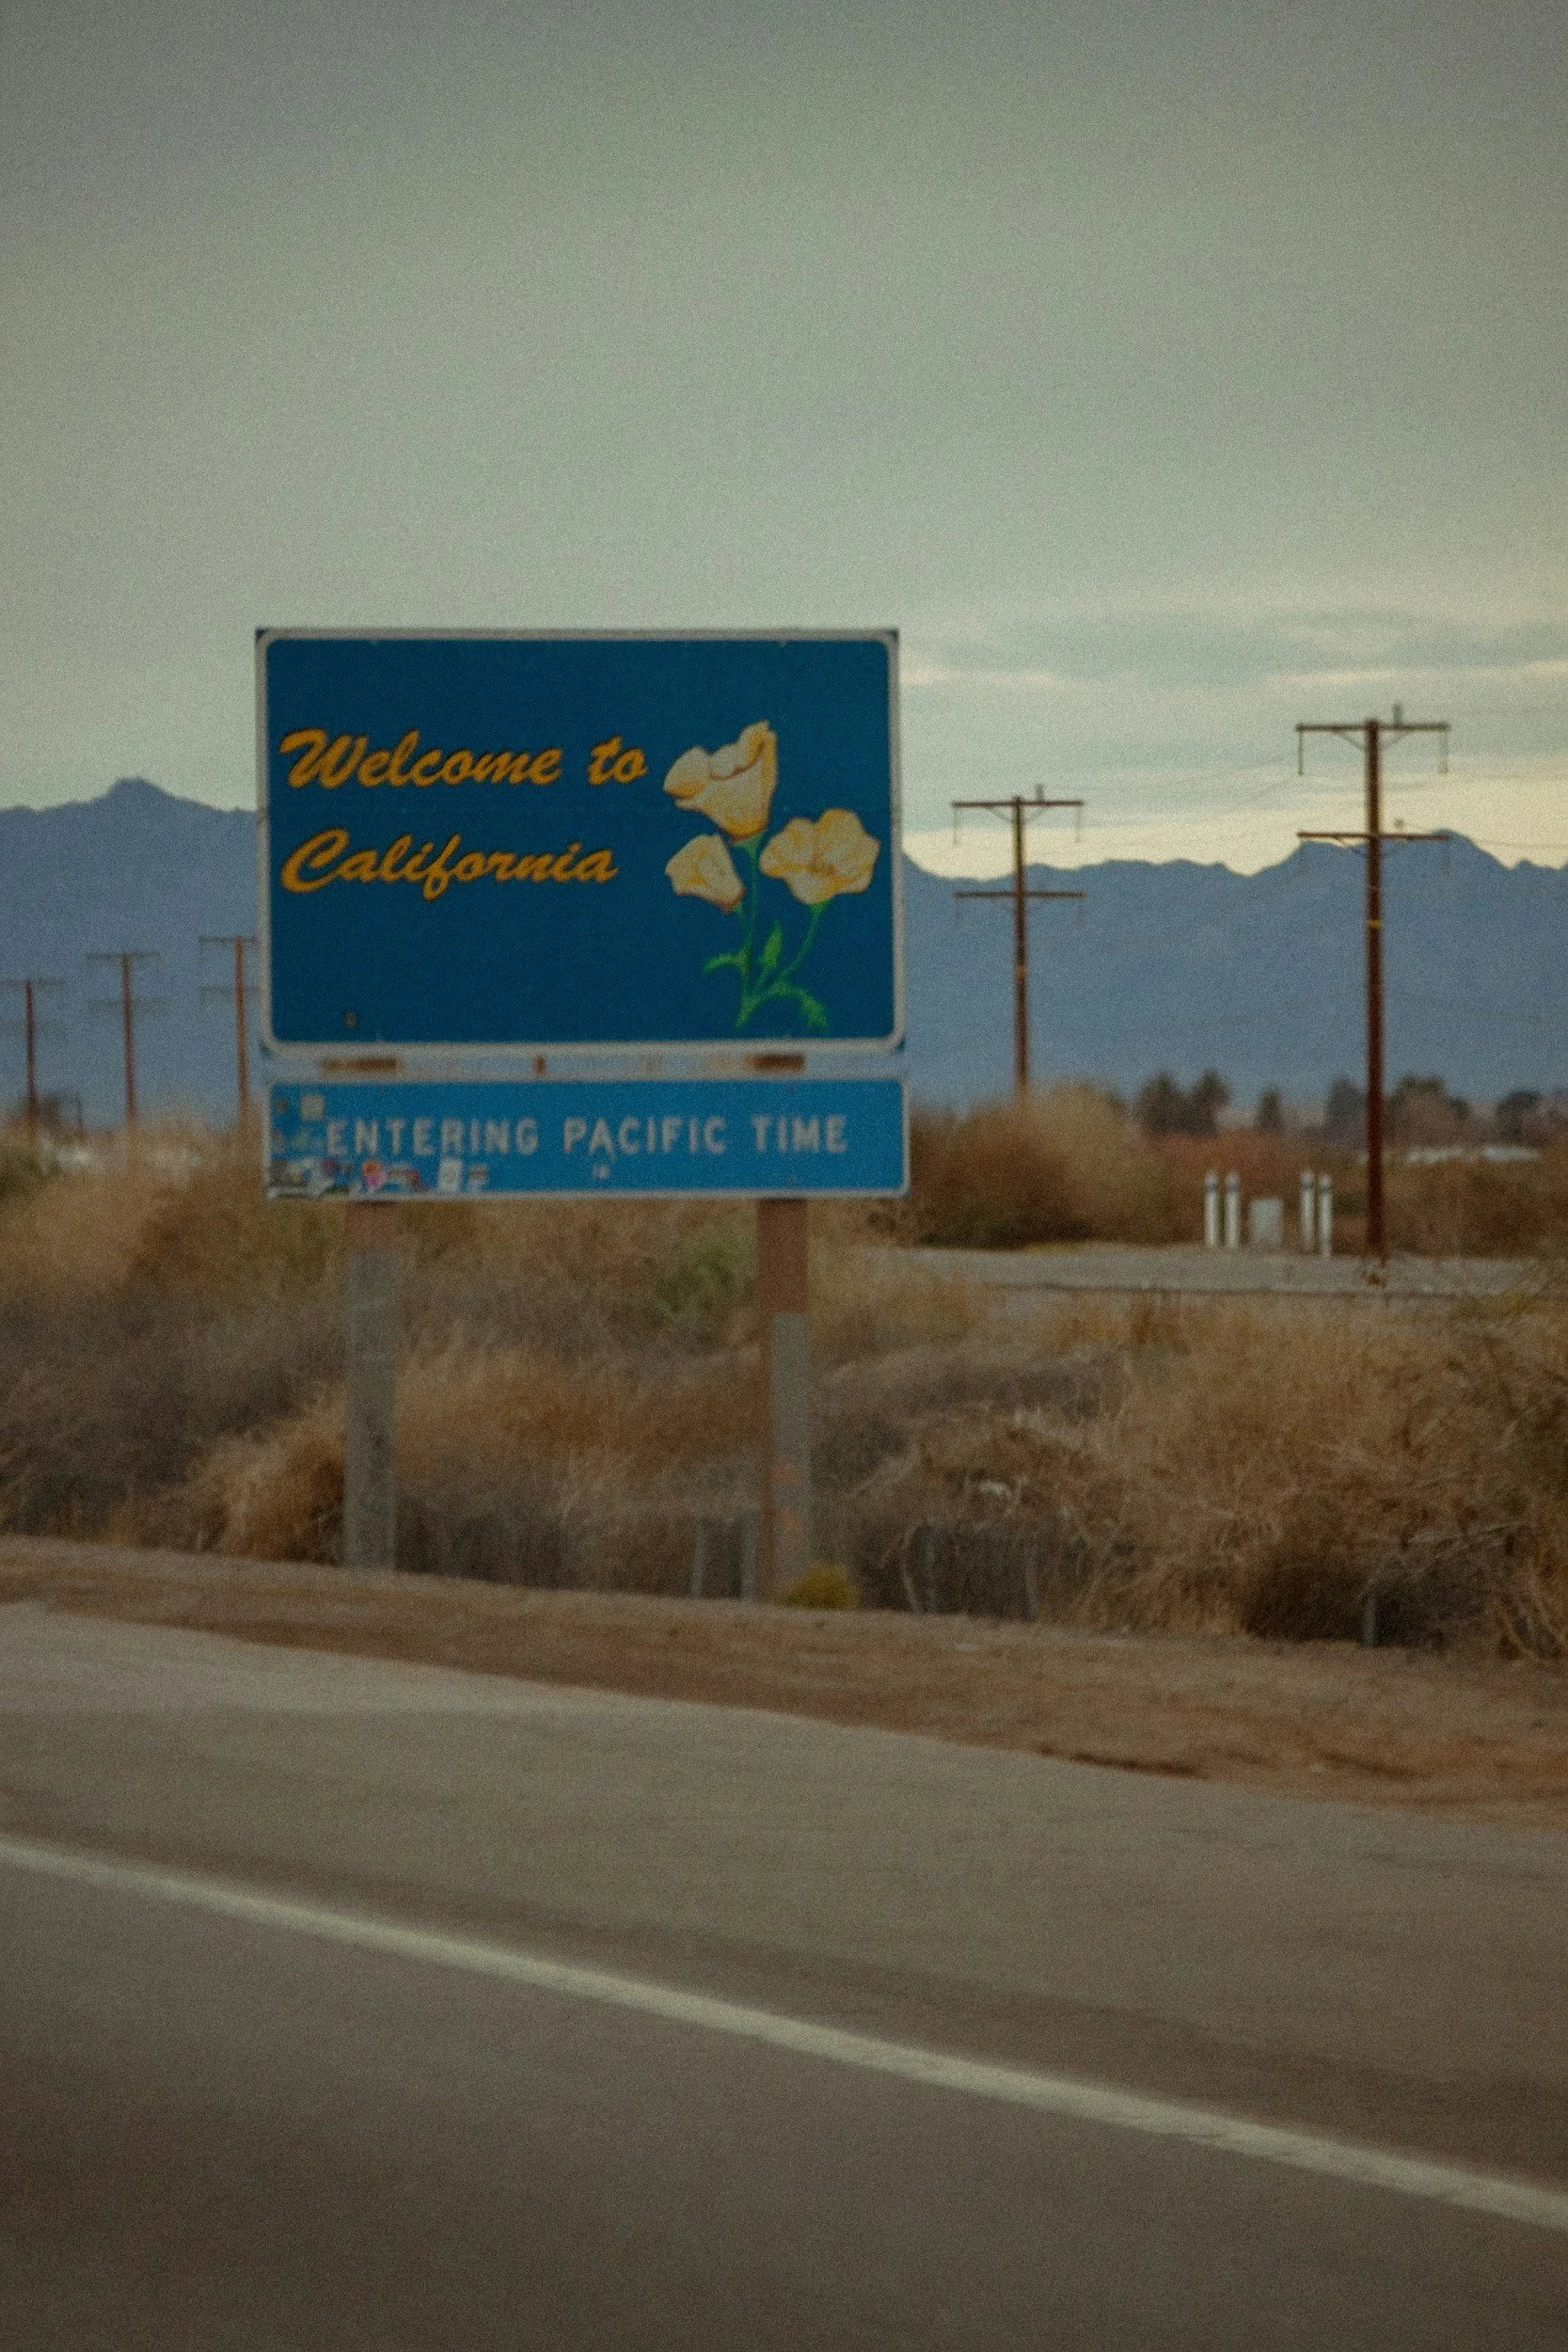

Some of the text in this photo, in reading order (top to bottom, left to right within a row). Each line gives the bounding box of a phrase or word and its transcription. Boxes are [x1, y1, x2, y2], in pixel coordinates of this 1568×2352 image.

[279, 728, 648, 789] Welcome to
[280, 827, 619, 901] California
[326, 1114, 848, 1157] ENTERING PACIFIC TIME
